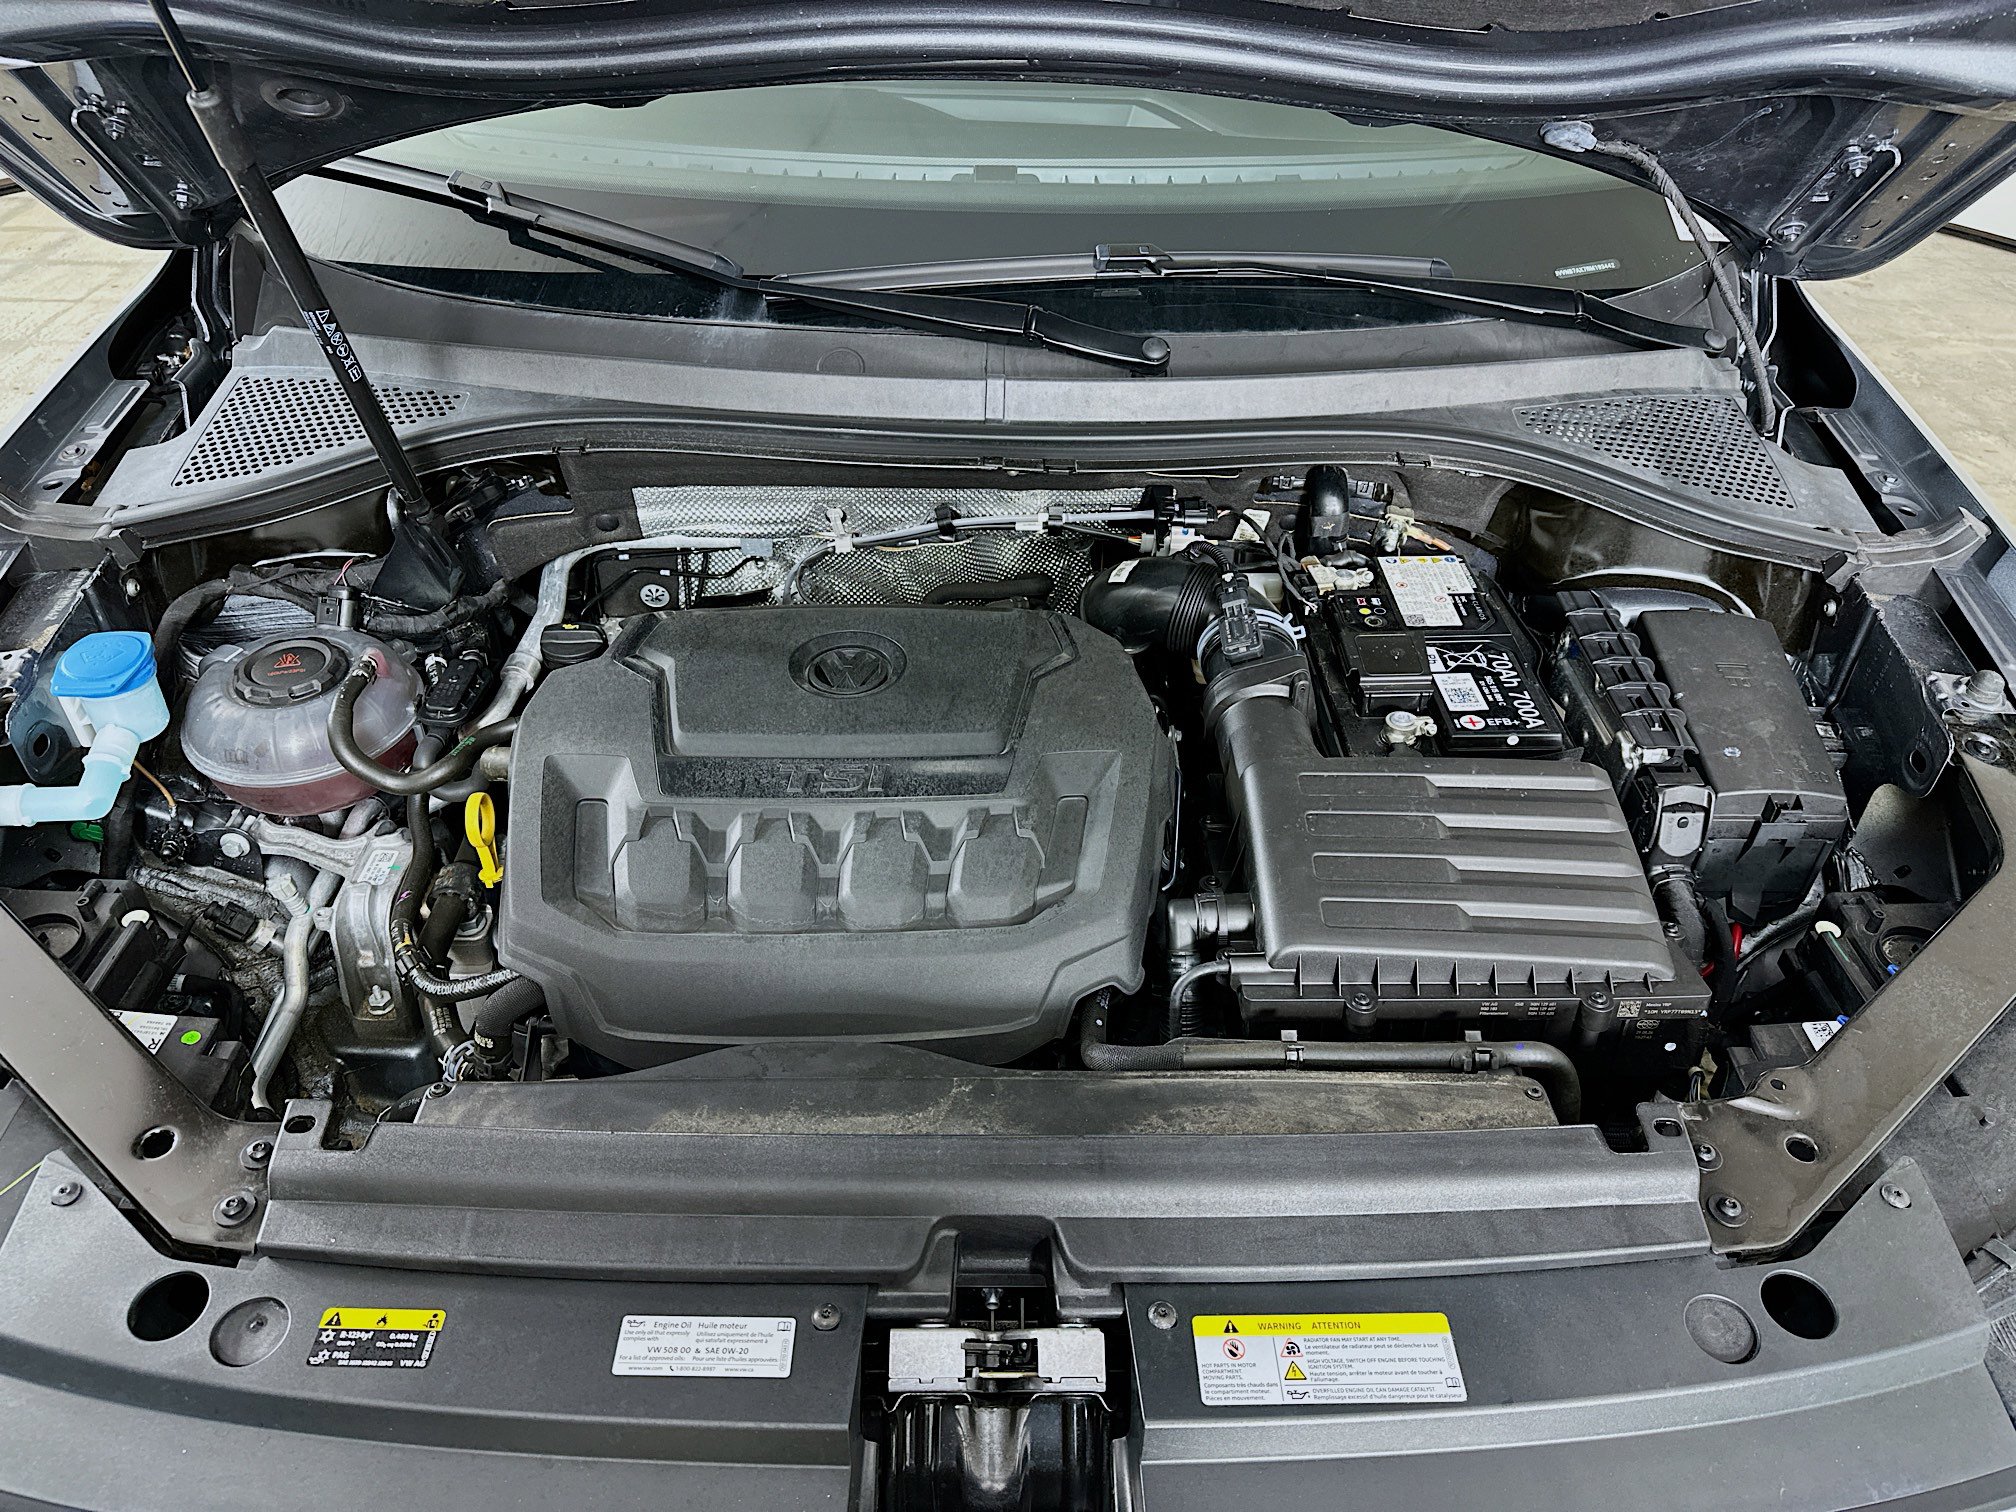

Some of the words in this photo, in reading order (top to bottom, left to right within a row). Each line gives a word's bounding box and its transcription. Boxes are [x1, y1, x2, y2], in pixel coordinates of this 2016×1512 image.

[1488, 652, 1521, 688] 70Ah
[1508, 690, 1545, 729] 700A
[1486, 717, 1520, 726] EFB+
[778, 764, 890, 792] TSI
[654, 1321, 679, 1329] Engine
[1258, 1322, 1302, 1331] WARNING
[1311, 1321, 1361, 1330] ATTENTION
[331, 1351, 350, 1359] PAG
[399, 1359, 414, 1367] VW
[413, 1360, 427, 1368] AG
